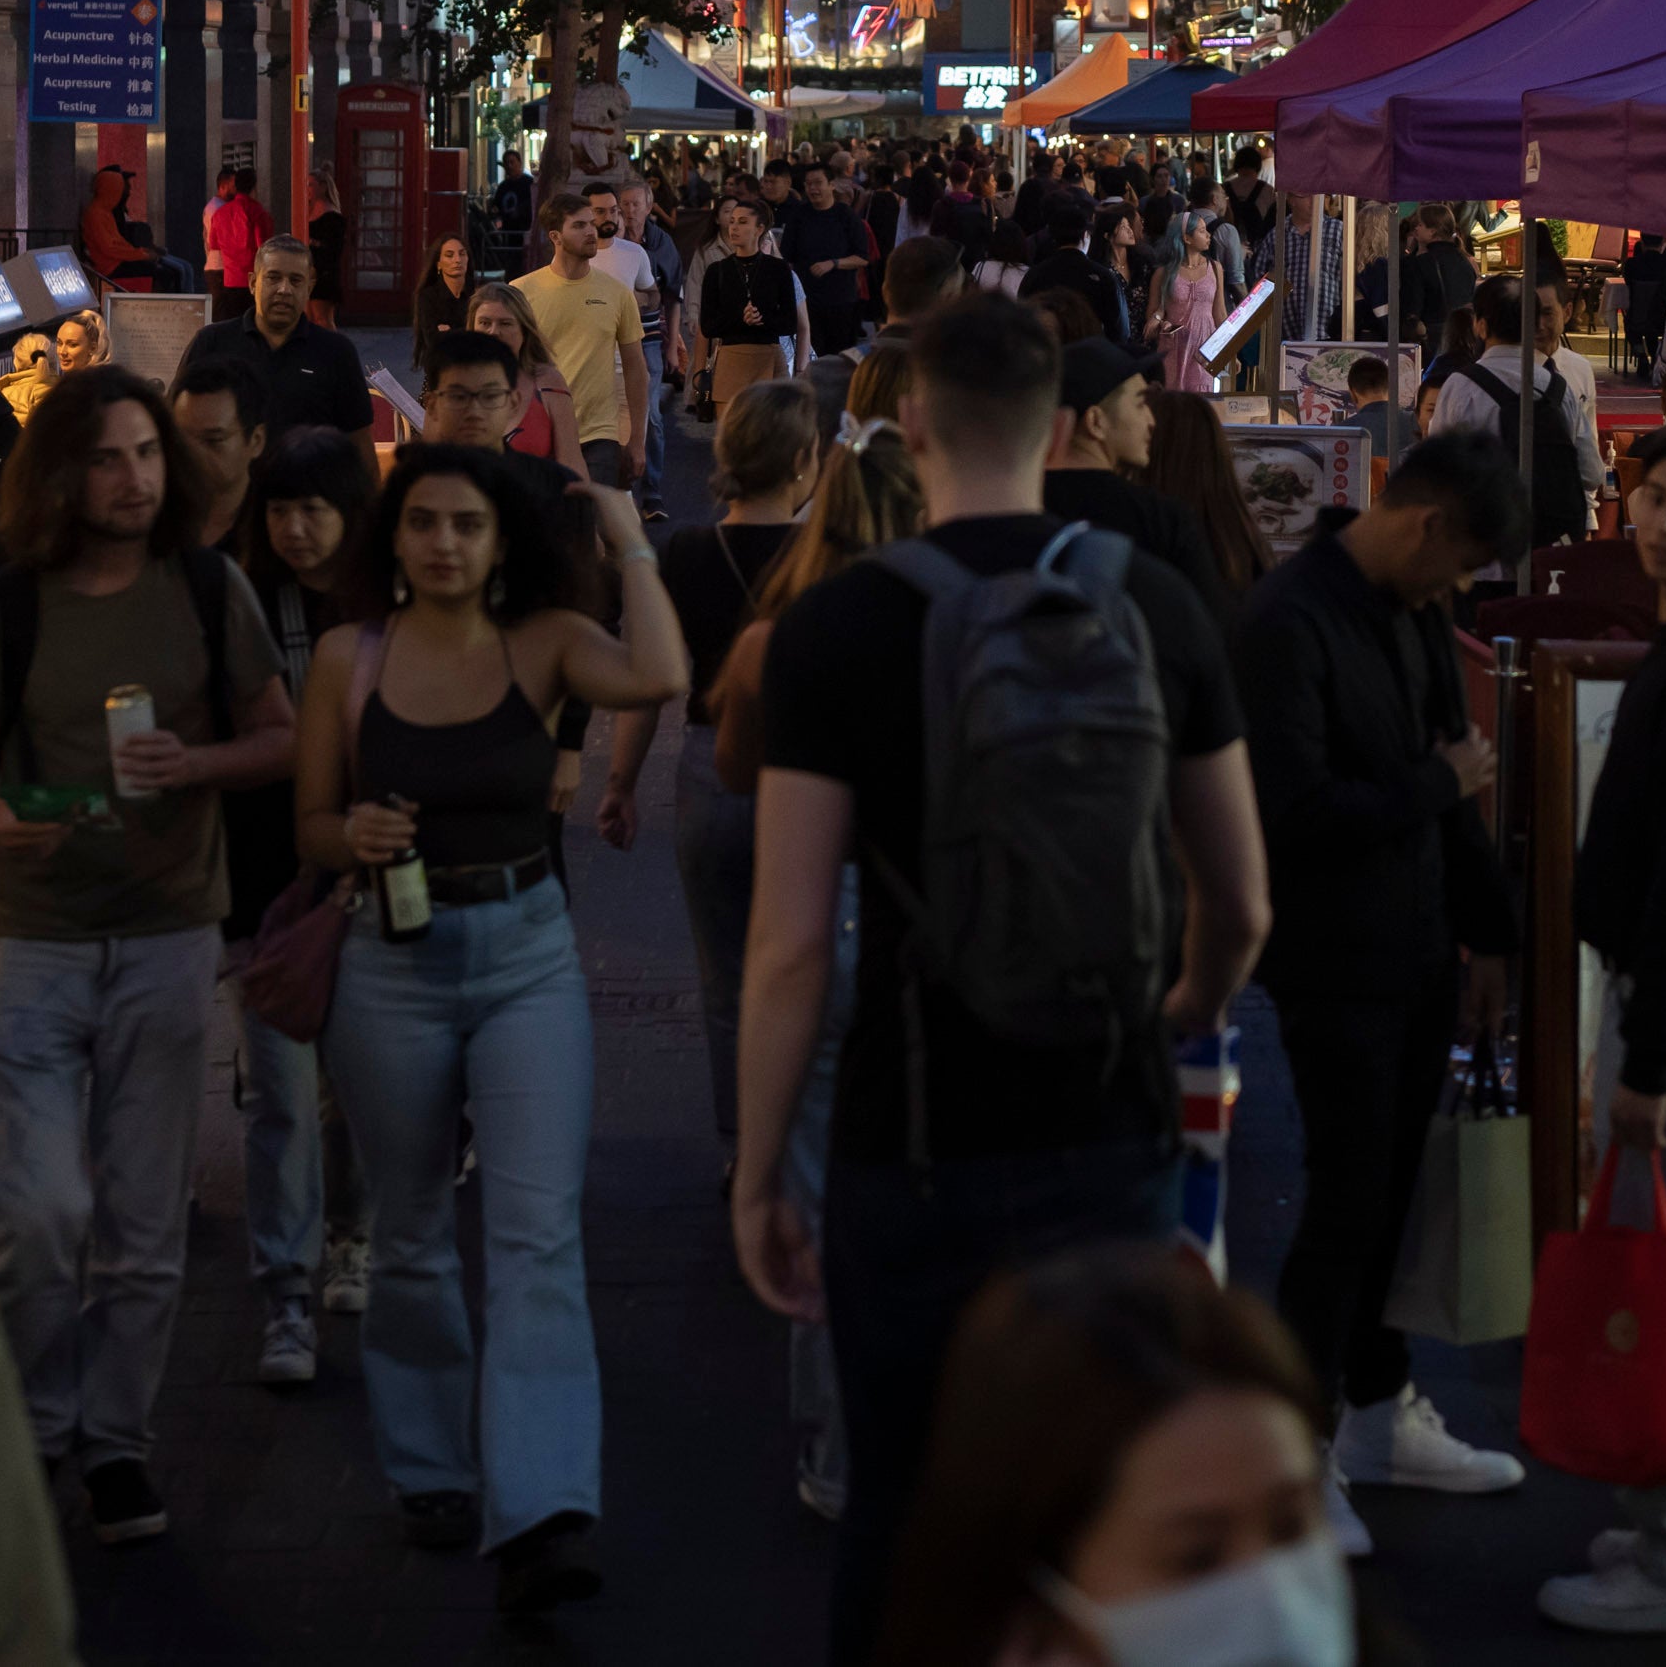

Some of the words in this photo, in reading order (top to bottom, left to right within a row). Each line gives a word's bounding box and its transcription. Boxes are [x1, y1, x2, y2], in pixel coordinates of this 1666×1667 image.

[44, 30, 115, 43] Acupuncture
[128, 32, 155, 46] 针灸
[34, 53, 70, 64] Herbal
[73, 54, 124, 66] Medicine
[129, 55, 154, 70] 中药
[44, 77, 112, 89] Acupressure
[127, 79, 154, 94] 推拿
[57, 100, 97, 115] Testing
[126, 103, 154, 118] 检测
